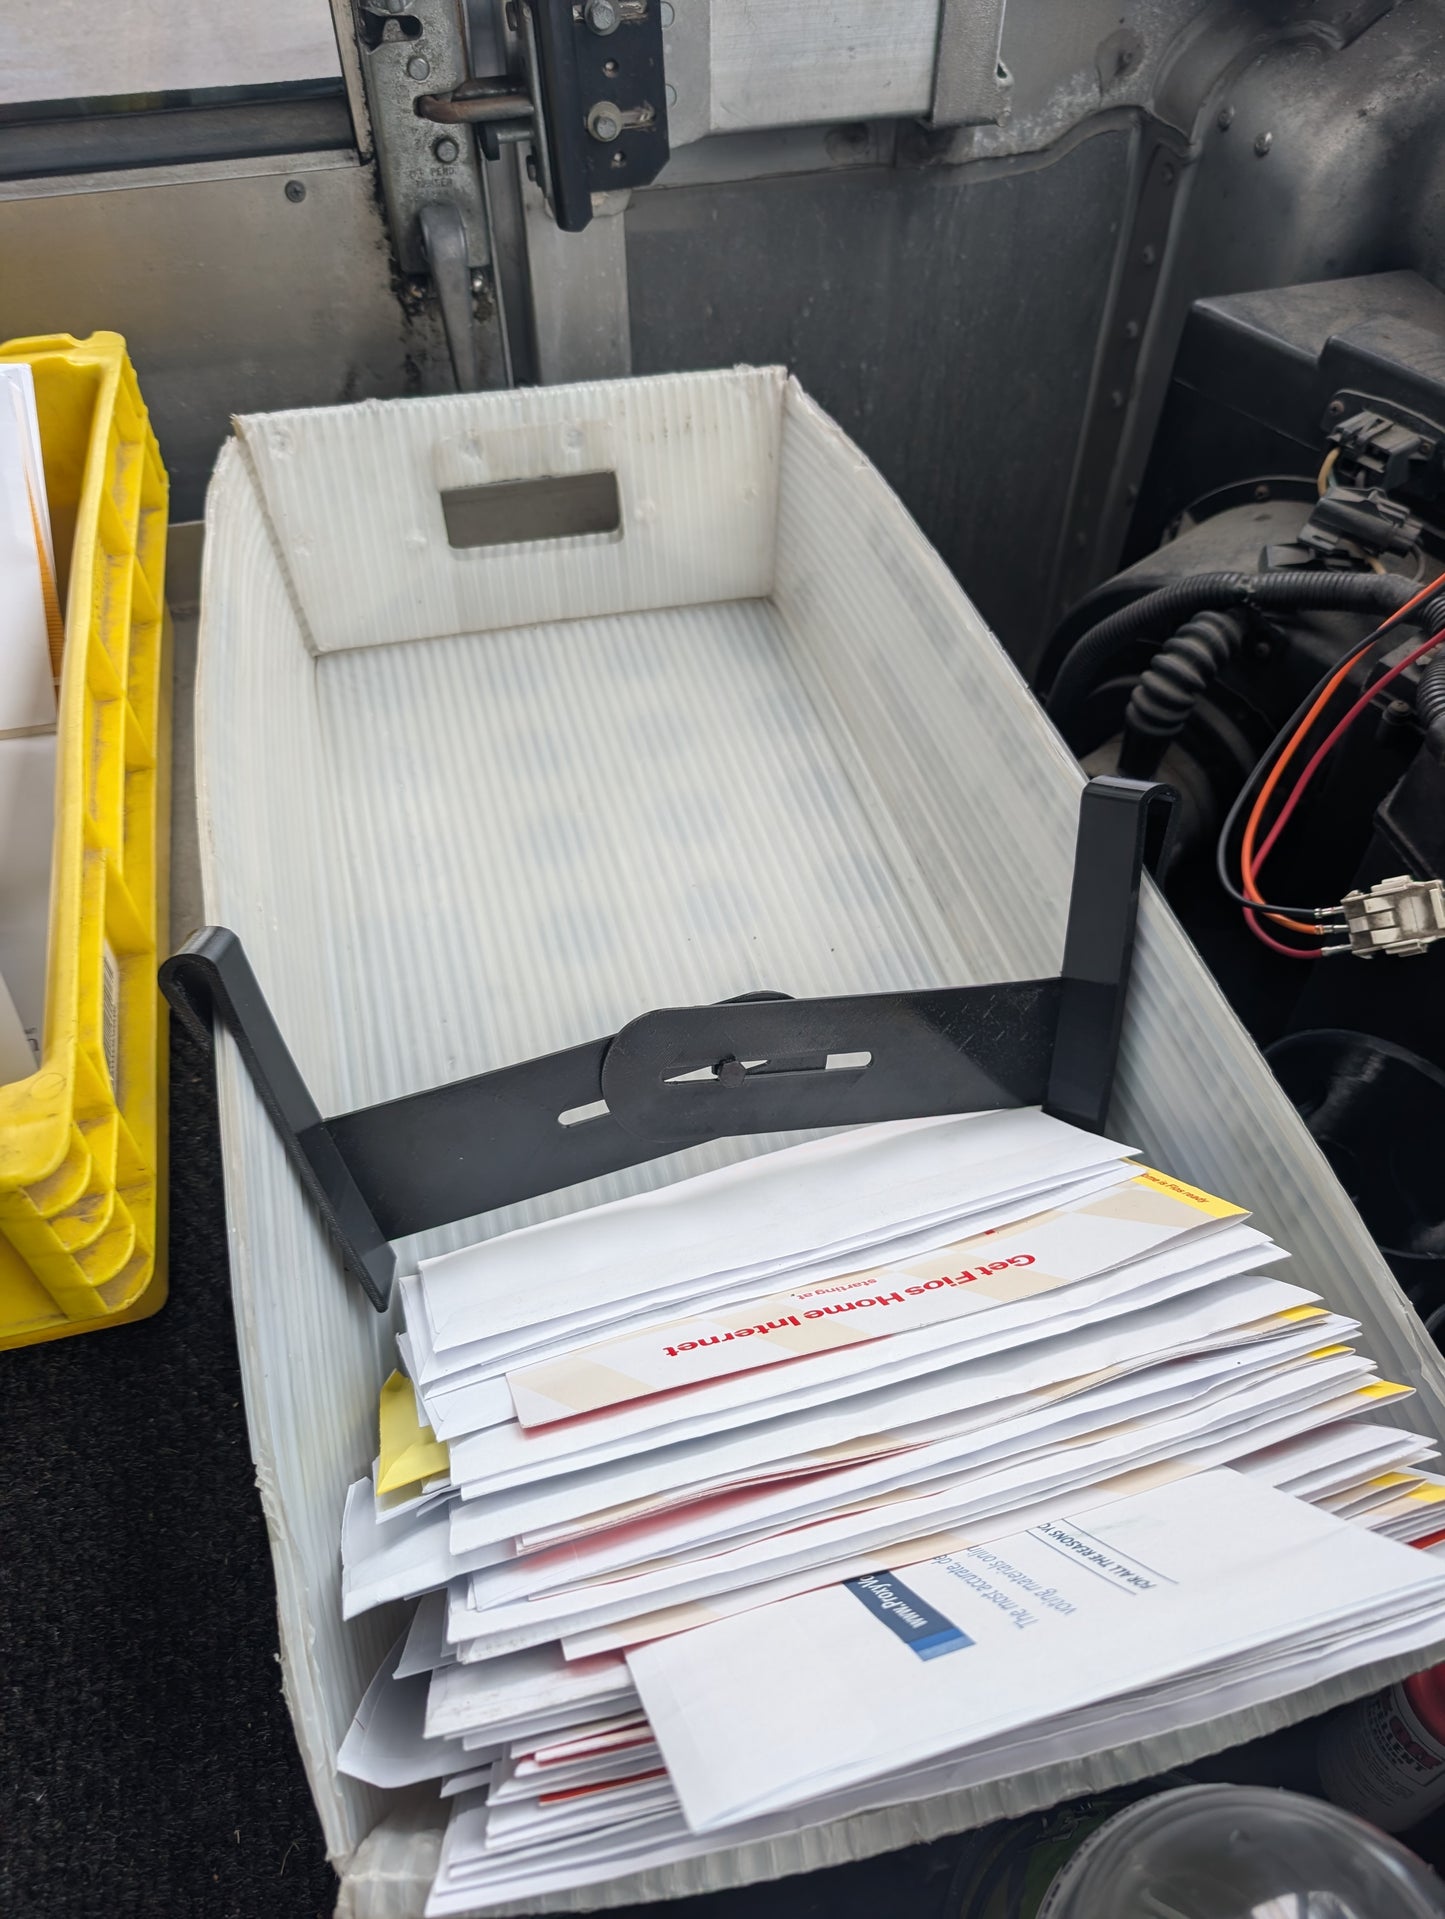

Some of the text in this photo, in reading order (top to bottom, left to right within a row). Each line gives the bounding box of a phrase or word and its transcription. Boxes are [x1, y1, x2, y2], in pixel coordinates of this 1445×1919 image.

[1141, 1172, 1160, 1183] ome
[1166, 1182, 1184, 1194] Fios
[1183, 1190, 1210, 1204] ready
[796, 1278, 878, 1301] starting at
[662, 1254, 1036, 1358] Get Fios Home Internet
[1048, 1530, 1097, 1557] REASONS
[1088, 1553, 1115, 1568] THE
[1109, 1564, 1135, 1578] ALL
[987, 1560, 1043, 1592] materials
[1126, 1577, 1157, 1590] FOR
[981, 1589, 1019, 1612] most
[1034, 1587, 1078, 1616] voting
[1010, 1608, 1039, 1630] The
